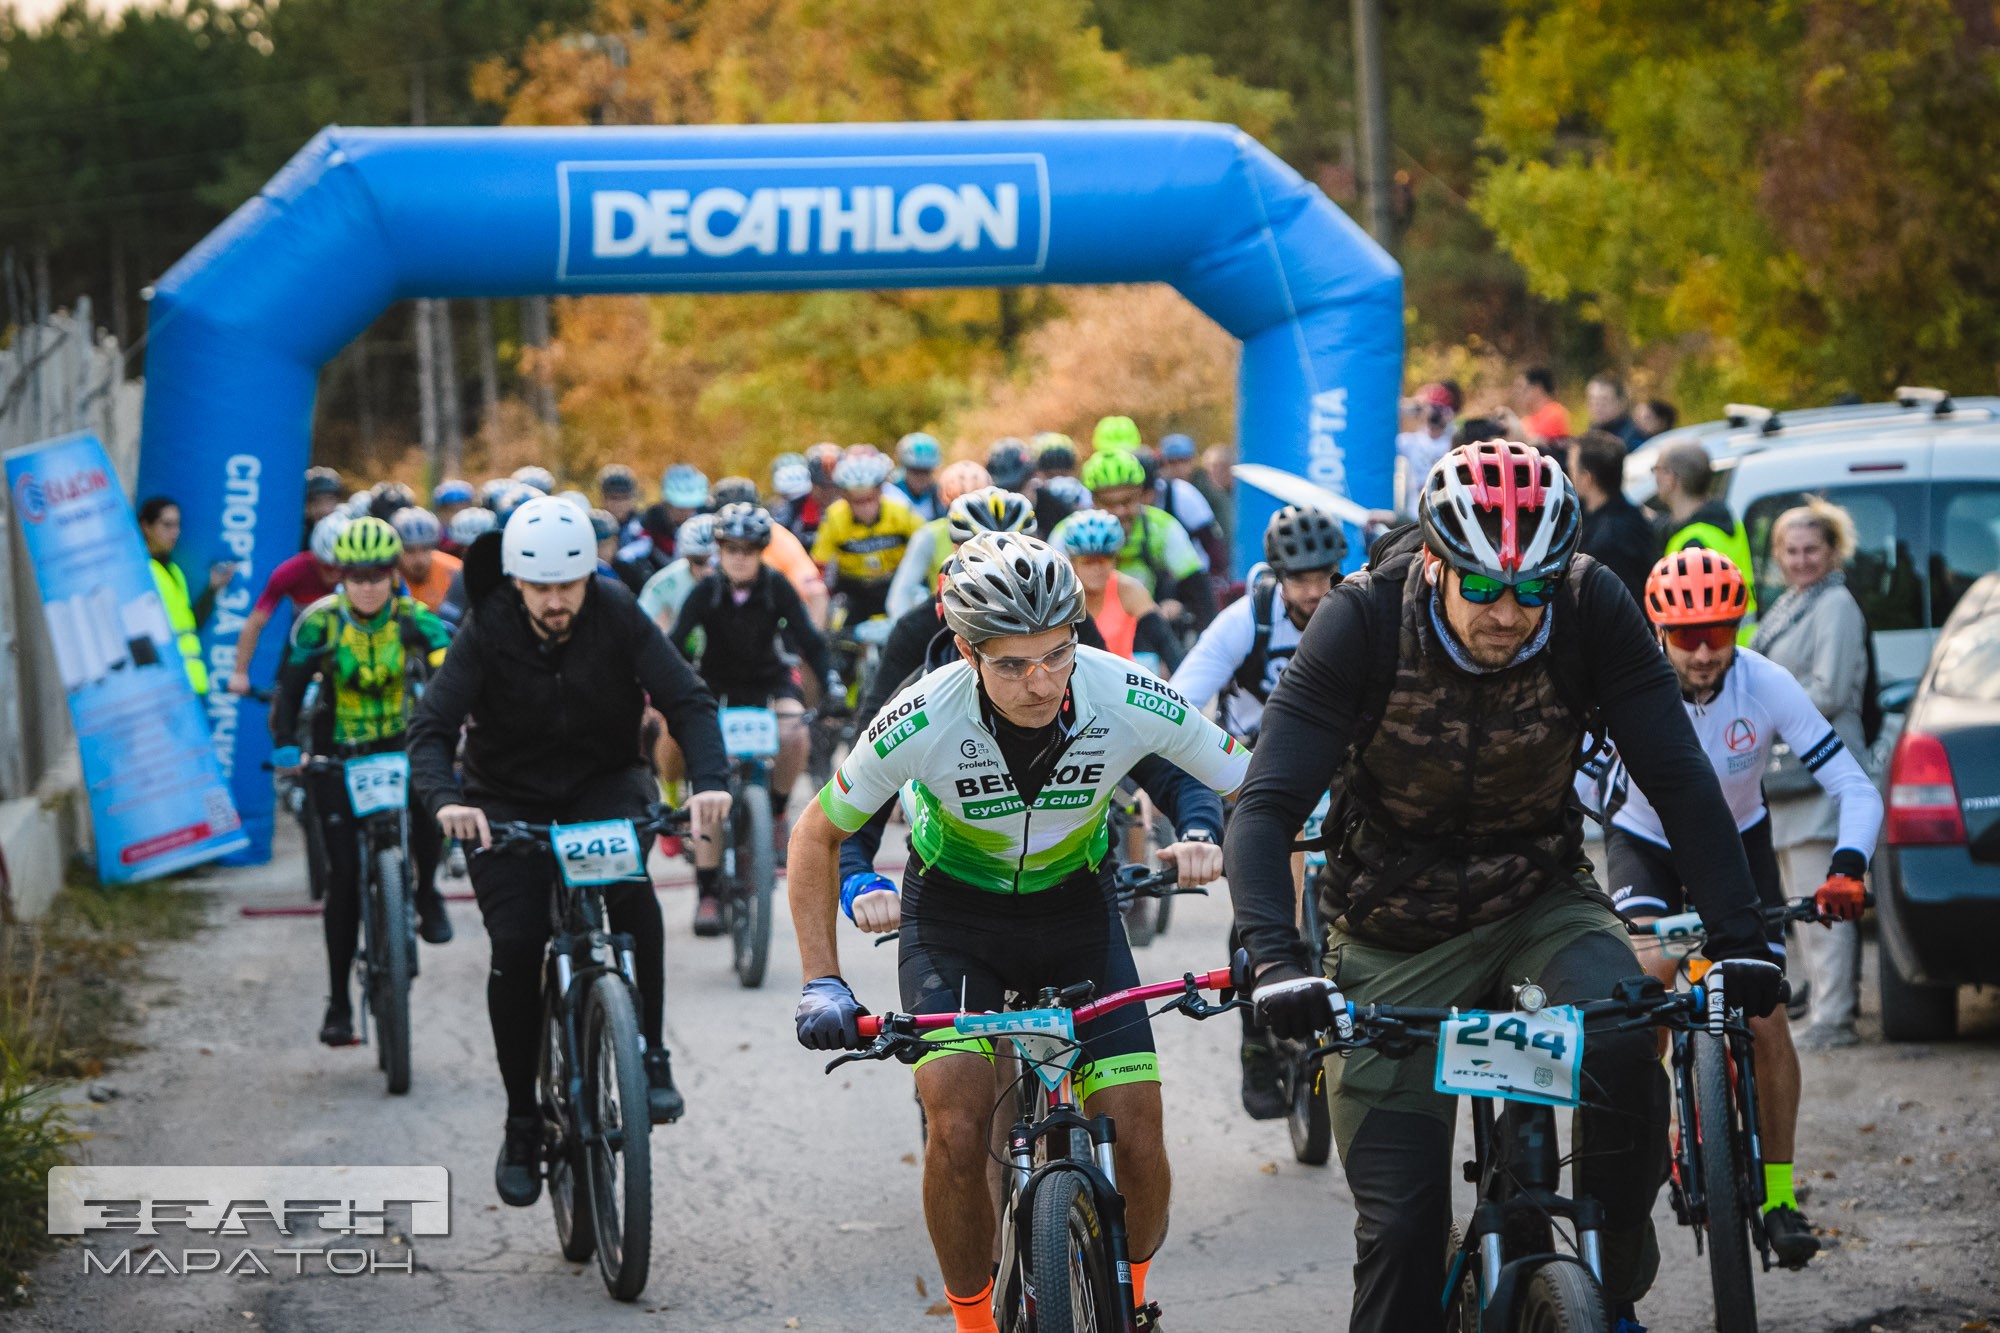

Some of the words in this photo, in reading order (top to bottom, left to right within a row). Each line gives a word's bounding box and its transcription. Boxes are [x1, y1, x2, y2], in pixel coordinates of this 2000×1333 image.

[592, 183, 1018, 257] DECATHLON
[1126, 673, 1189, 709] BEROE
[1133, 692, 1180, 720] ROAD
[868, 694, 927, 743] BEROE
[881, 719, 916, 751] MTB
[969, 797, 1046, 817] cycling
[1050, 794, 1089, 805] club
[565, 837, 628, 860] 242
[1457, 1016, 1566, 1060] 244
